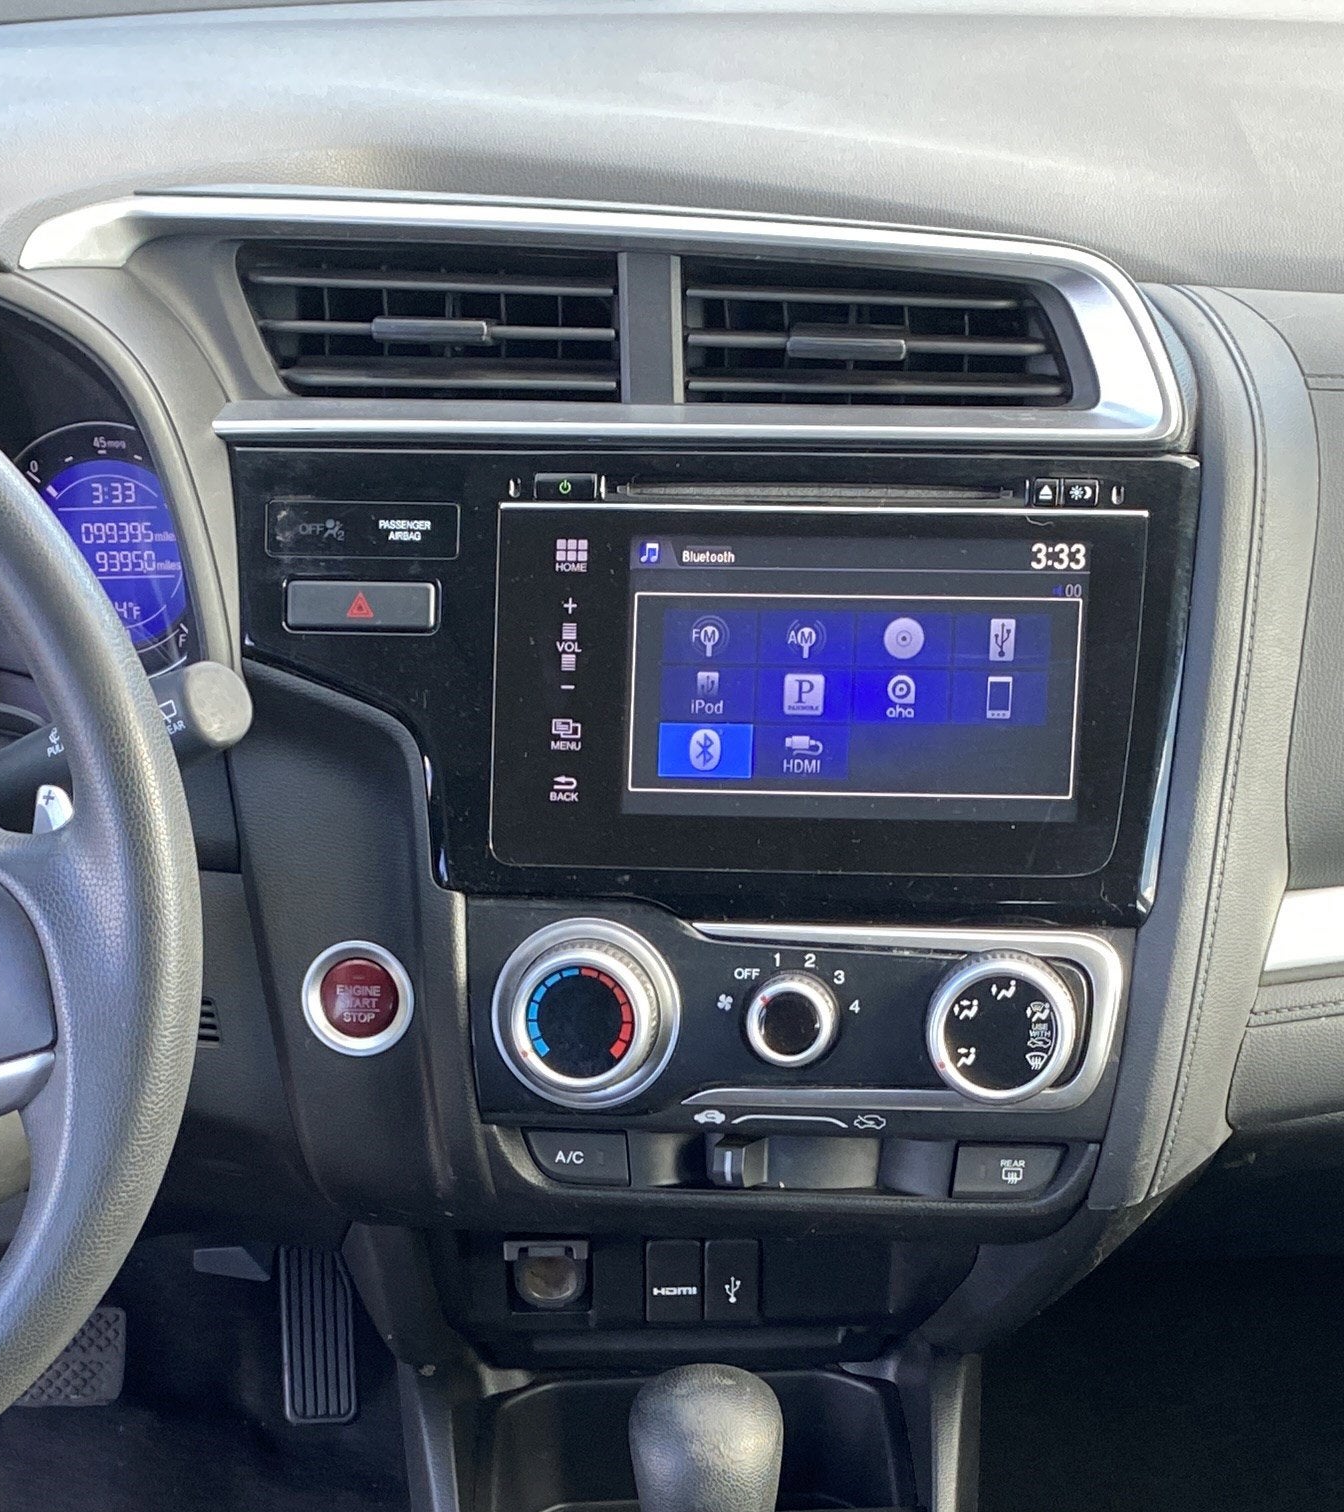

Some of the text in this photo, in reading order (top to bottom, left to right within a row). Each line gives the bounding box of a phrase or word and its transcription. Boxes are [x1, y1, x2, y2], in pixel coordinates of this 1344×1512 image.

[29, 460, 39, 473] 0
[91, 483, 136, 504] 3:33
[299, 523, 324, 535] OFF
[378, 519, 431, 531] PASSENGER
[81, 522, 177, 544] 099395 mile
[388, 531, 422, 541] AIRBAG
[681, 549, 736, 564] Bluetooth
[1030, 542, 1086, 570] 3:33
[555, 563, 588, 573] HOME
[1065, 583, 1082, 598] 00
[178, 633, 187, 648] F
[692, 628, 716, 643] FM
[787, 630, 813, 645] AM
[556, 641, 582, 653] VOL
[794, 679, 814, 704] P
[690, 699, 724, 715] iPod
[886, 704, 915, 718] aha
[167, 720, 186, 735] EAR
[551, 740, 582, 751] MENU
[783, 758, 821, 774] HDMI
[550, 791, 579, 802] BACK
[774, 952, 817, 968] 1 2
[734, 967, 761, 980] OFF
[833, 969, 846, 985] 3
[336, 984, 381, 997] ENGINE
[849, 998, 861, 1014] 4
[343, 1011, 376, 1023] STOP
[1029, 1029, 1051, 1038] WITH
[1032, 1022, 1049, 1031] USE
[555, 1150, 584, 1165] A/C
[1000, 1159, 1025, 1168] REAR
[653, 1286, 697, 1296] HDMI
